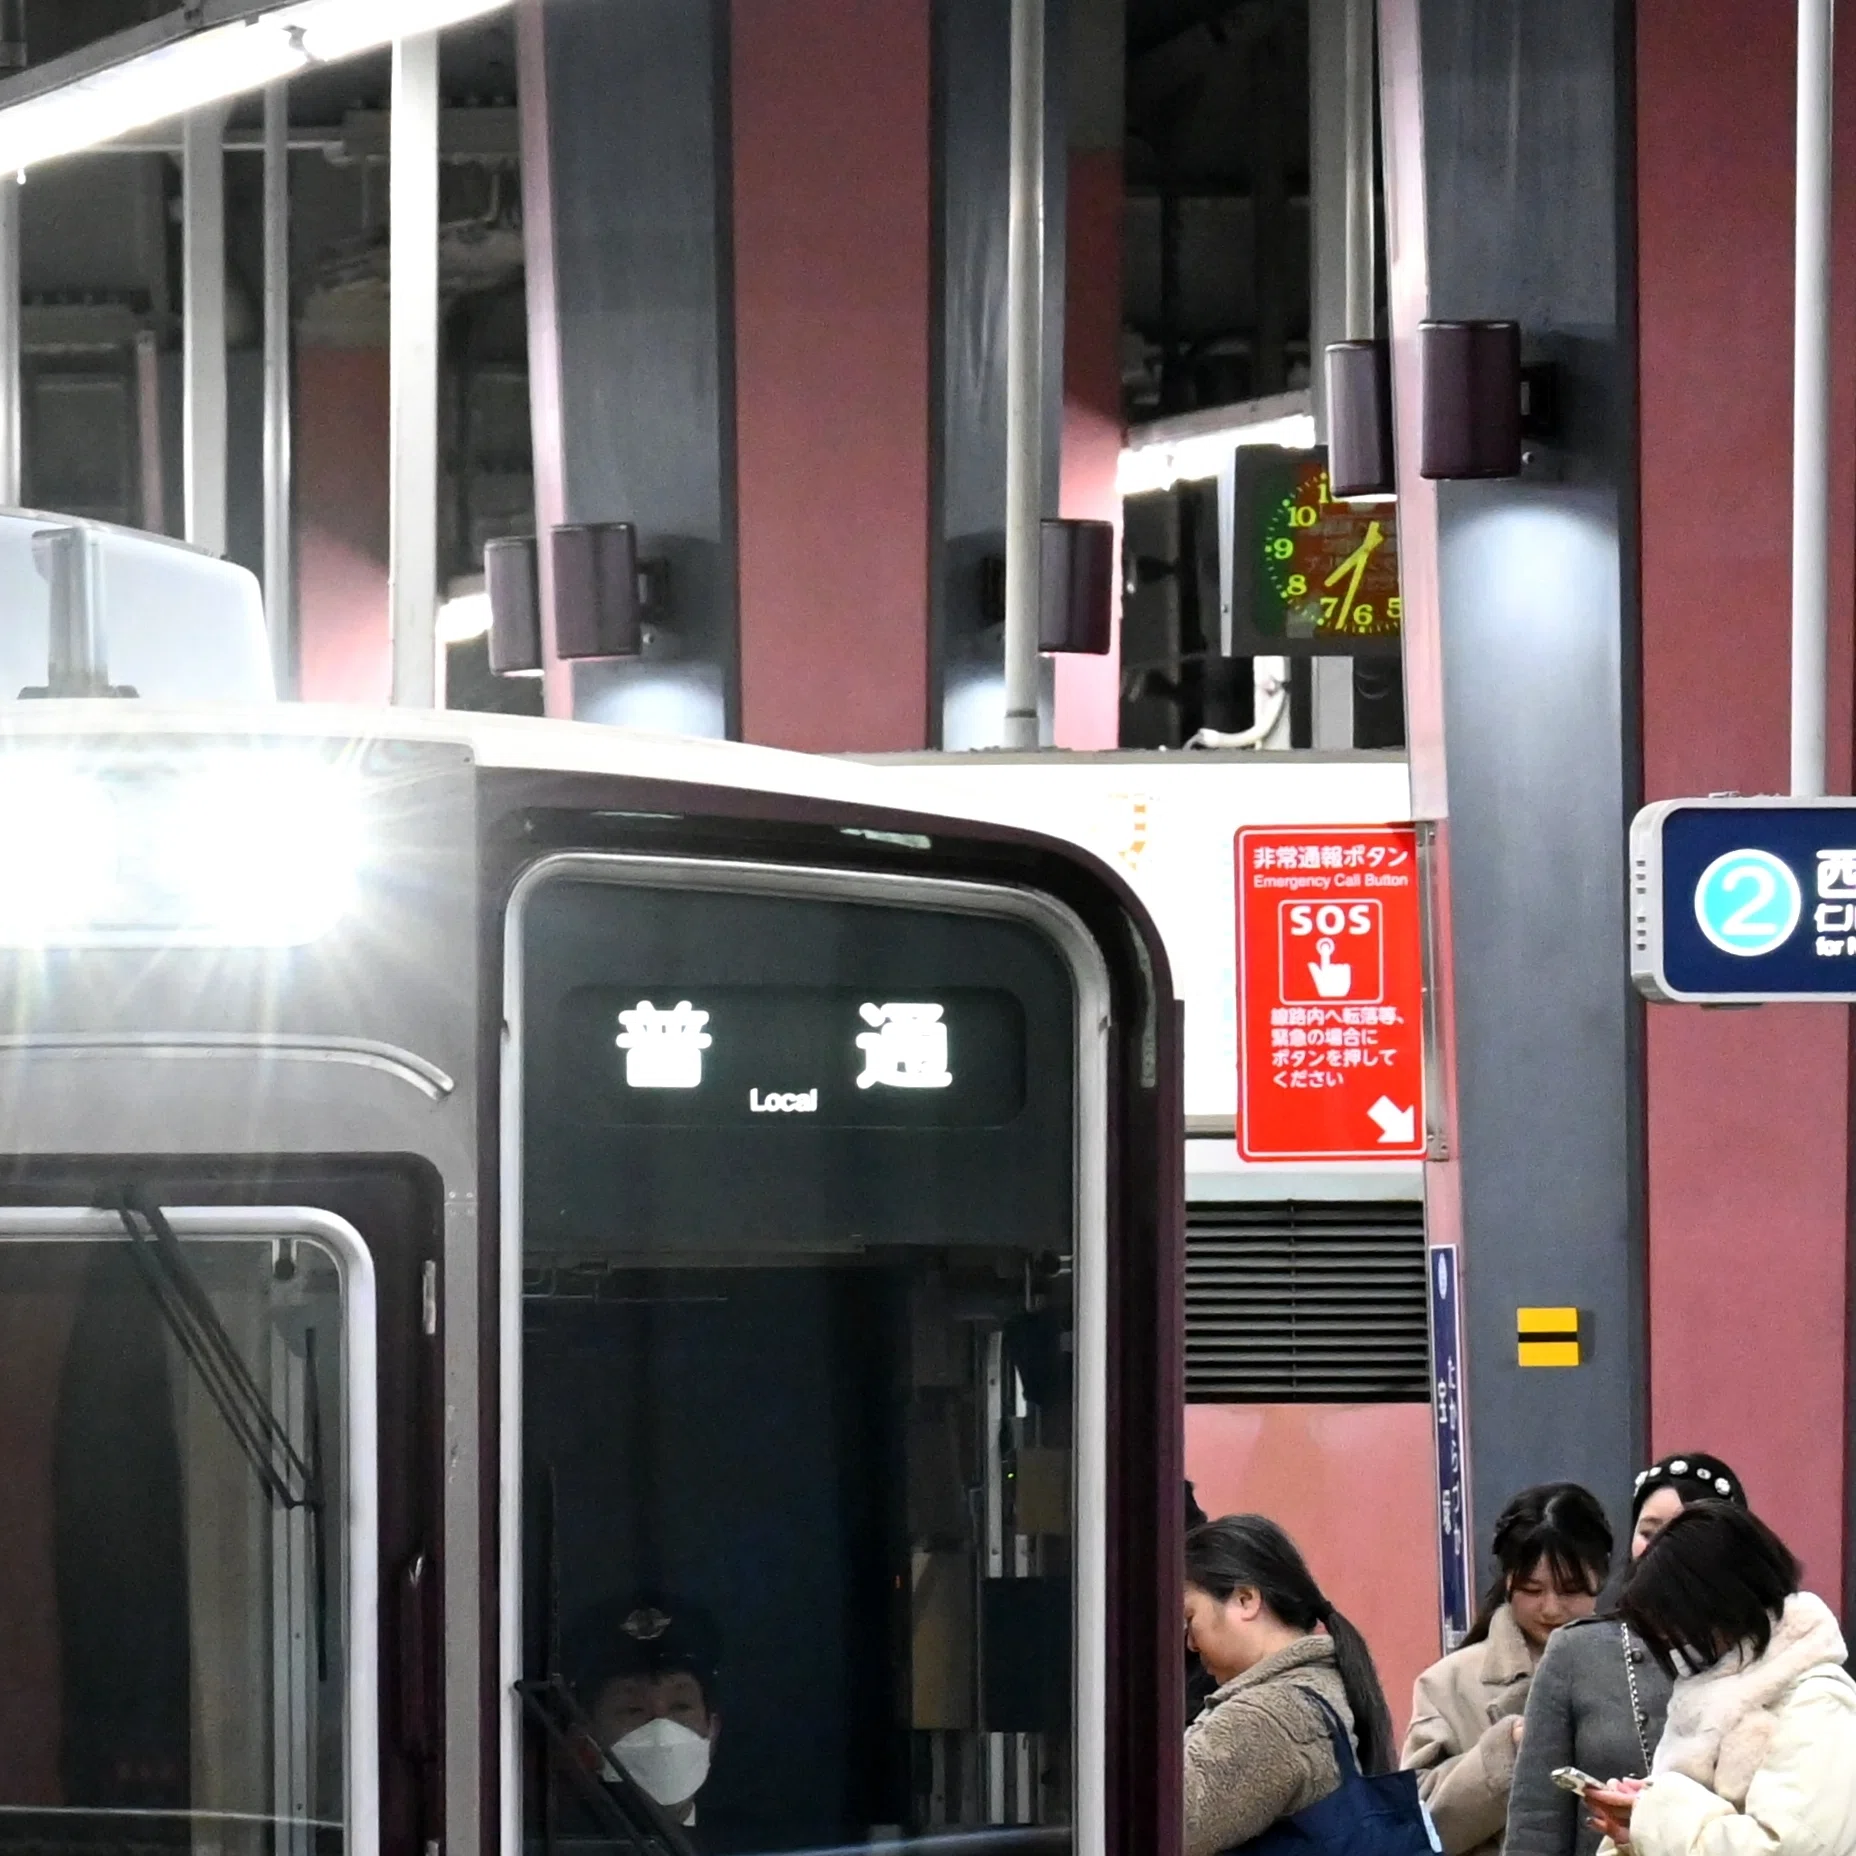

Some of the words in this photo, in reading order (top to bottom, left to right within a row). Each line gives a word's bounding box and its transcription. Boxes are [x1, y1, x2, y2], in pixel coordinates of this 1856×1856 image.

[1288, 506, 1317, 527] 10
[1274, 538, 1294, 560] 9
[1287, 574, 1307, 595] 8
[1320, 597, 1339, 618] 7
[1353, 604, 1373, 625] 6
[1253, 844, 1408, 870] 非常通報ボタン
[1253, 874, 1331, 891] Emergency
[1334, 873, 1361, 888] Call
[1364, 873, 1409, 888] Button
[1289, 904, 1371, 937] SOS
[1271, 1049, 1397, 1068] ボタンを押して
[1273, 1070, 1344, 1088] ください
[749, 1087, 819, 1113] Local
